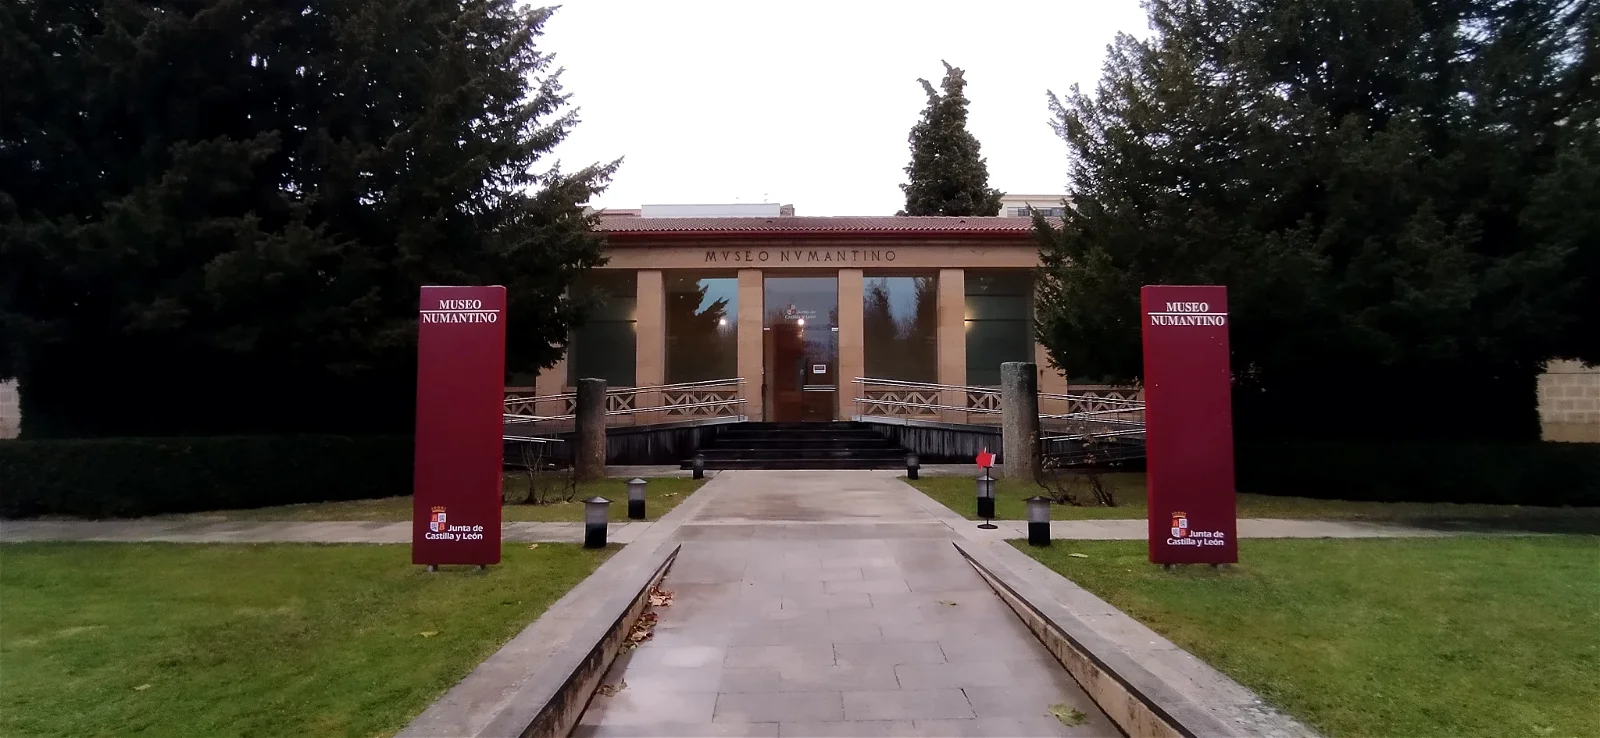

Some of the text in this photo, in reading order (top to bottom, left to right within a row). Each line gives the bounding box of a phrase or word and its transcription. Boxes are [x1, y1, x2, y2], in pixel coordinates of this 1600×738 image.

[439, 299, 482, 310] MUSEO
[1166, 302, 1209, 312] MUSEO
[423, 312, 498, 324] NUMANTINO
[1151, 315, 1225, 326] NUMANTINO
[448, 524, 484, 532] Junta de
[425, 532, 483, 542] Castilla y León
[1189, 529, 1225, 538] Junta de
[1166, 537, 1225, 547] Castilla y León
